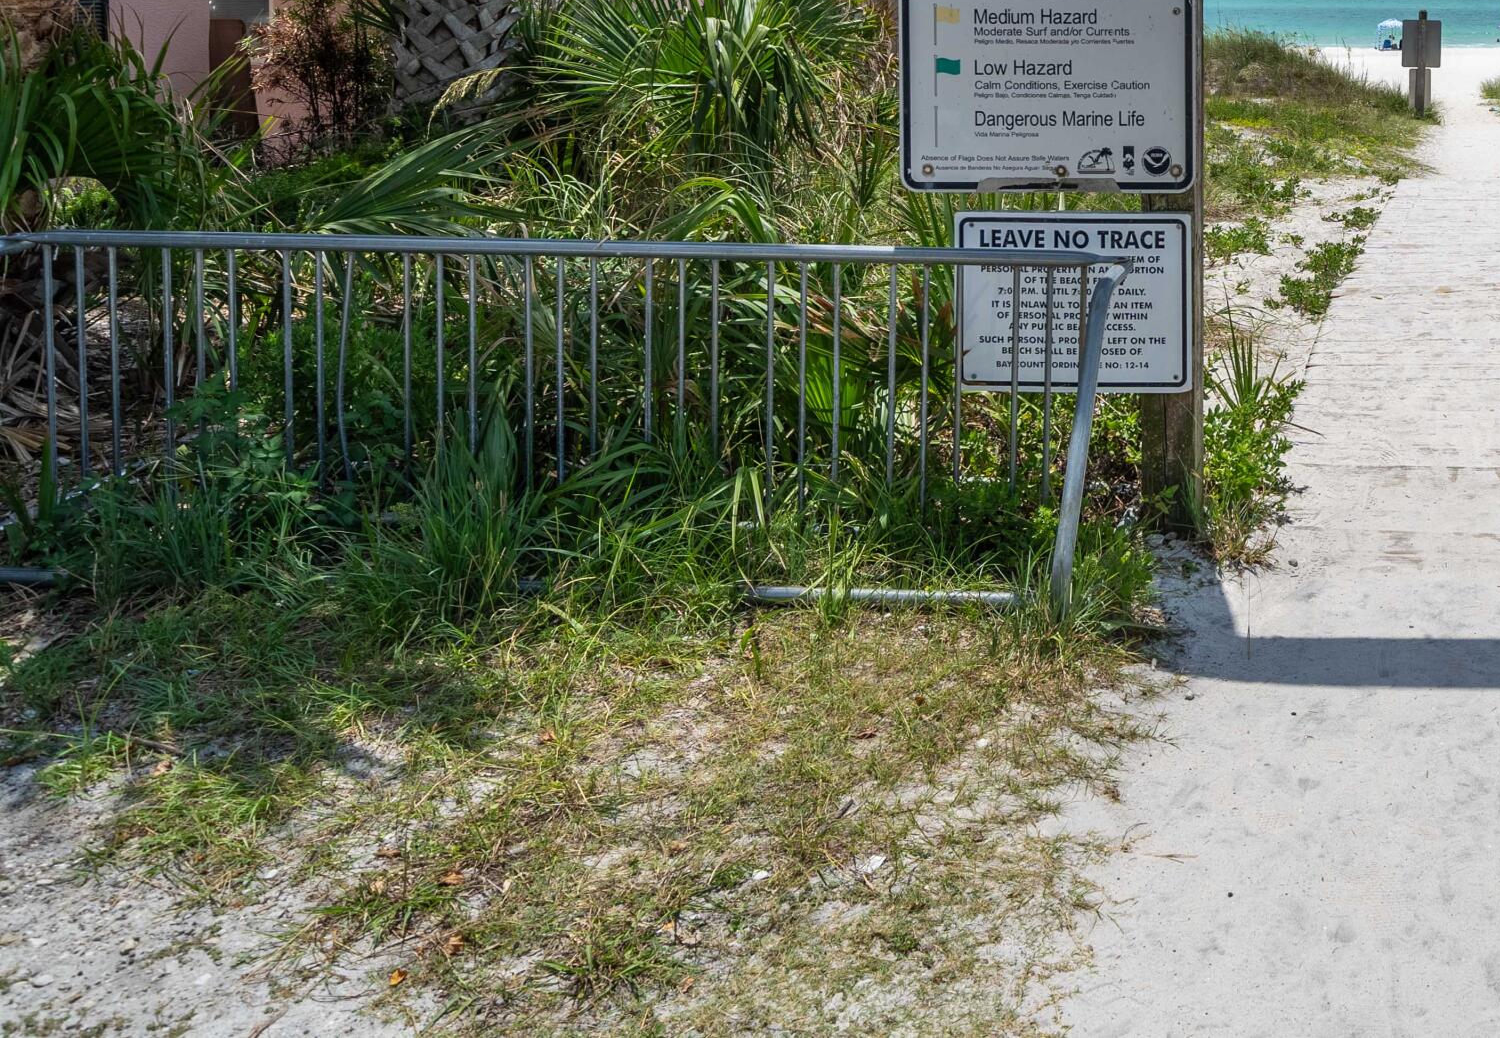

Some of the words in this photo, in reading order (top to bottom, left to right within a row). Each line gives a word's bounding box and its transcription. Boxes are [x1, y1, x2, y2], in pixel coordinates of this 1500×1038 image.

[973, 8, 1035, 25] Medium
[1041, 8, 1097, 25] Hazard
[973, 26, 1023, 37] Moderate
[1026, 26, 1048, 36] Surf
[1050, 27, 1083, 37] and/or
[1086, 27, 1130, 37] Currents
[974, 59, 1008, 76] Low
[1013, 59, 1072, 76] Hazard
[974, 80, 1001, 90] Calm
[1004, 80, 1060, 91] Conditions,
[1064, 80, 1108, 90] Exercise
[1111, 80, 1150, 90] Caution
[974, 110, 1057, 130] Dangerous
[1062, 110, 1113, 126] Marine
[1118, 110, 1145, 126] Life
[979, 229, 1045, 248] LEAVE
[1053, 229, 1089, 249] NO
[1097, 230, 1165, 249] TRACE
[1147, 255, 1161, 263] OF
[1024, 276, 1037, 284] OF
[1060, 276, 1090, 285] BEAC
[1021, 287, 1039, 295] P.M.
[1118, 288, 1146, 296] DAILY.
[991, 300, 1000, 308] IT
[1002, 300, 1011, 308] IS
[1016, 300, 1065, 309] NLAWUL
[1068, 301, 1080, 309] TO
[1131, 302, 1153, 310] ITEM
[996, 311, 1009, 319] OF
[1015, 312, 1061, 320] ERSONAL
[1112, 312, 1148, 320] WITHIN
[1102, 323, 1136, 332] CCESS.
[979, 335, 1004, 344] SUCH
[1007, 336, 1056, 344] PRSONL
[1130, 337, 1146, 345] ON
[1148, 337, 1166, 345] THE
[1002, 346, 1032, 355] BECH
[1034, 347, 1063, 355] SHLL
